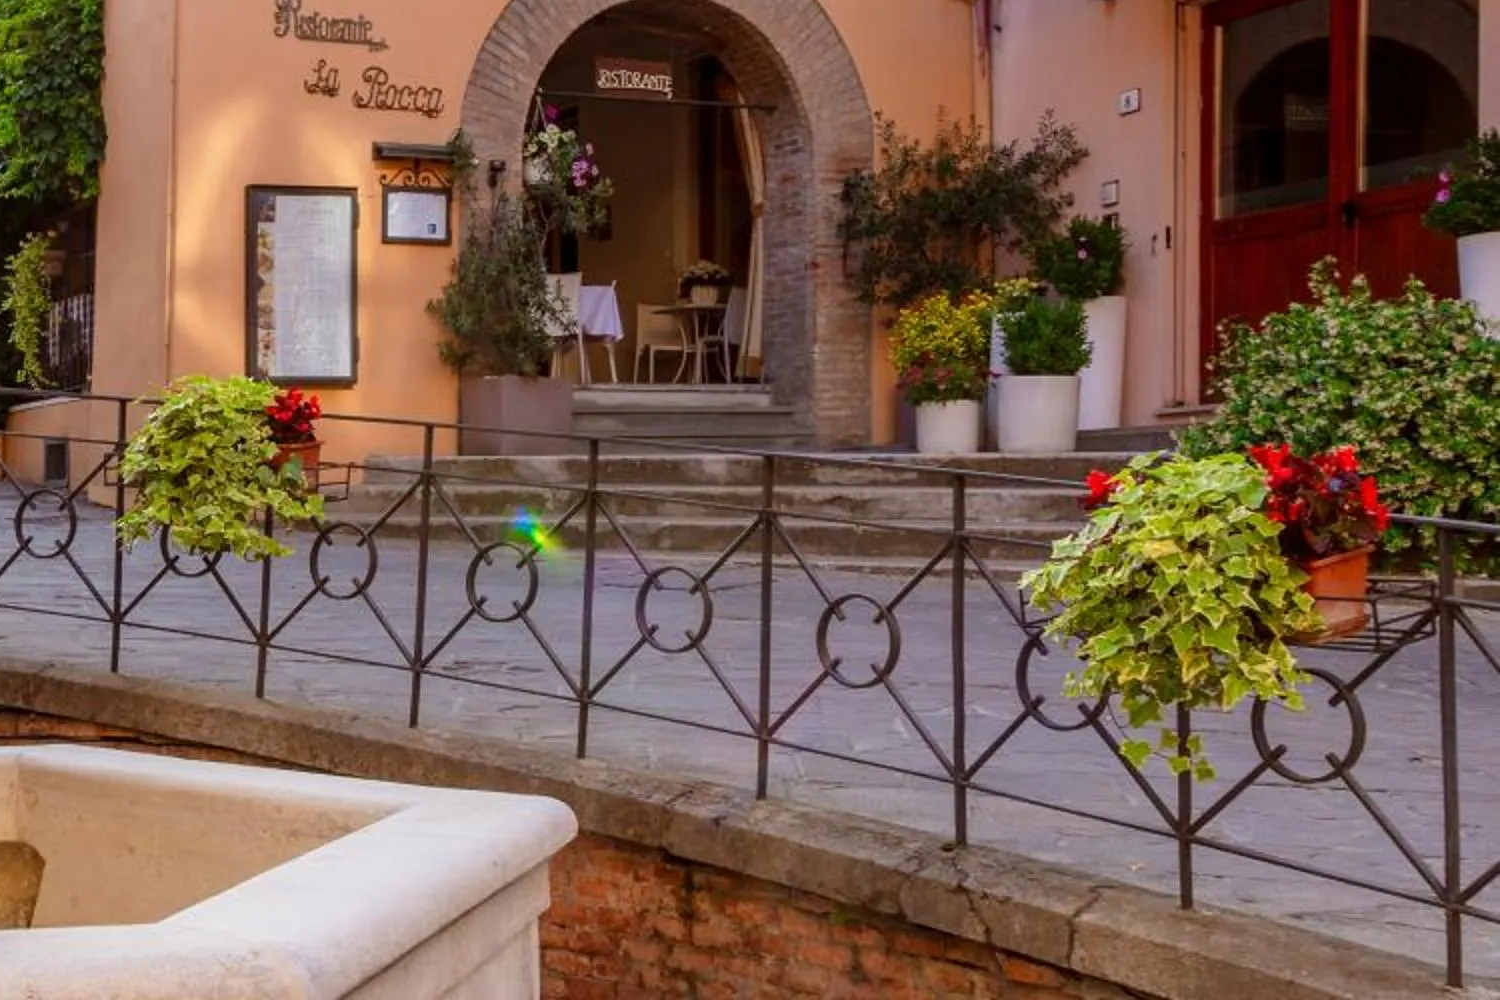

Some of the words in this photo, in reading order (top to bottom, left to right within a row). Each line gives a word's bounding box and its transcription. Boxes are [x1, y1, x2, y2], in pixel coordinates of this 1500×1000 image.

[304, 58, 340, 98] La
[352, 66, 444, 118] Rocca
[597, 69, 673, 97] RISTORANTE
